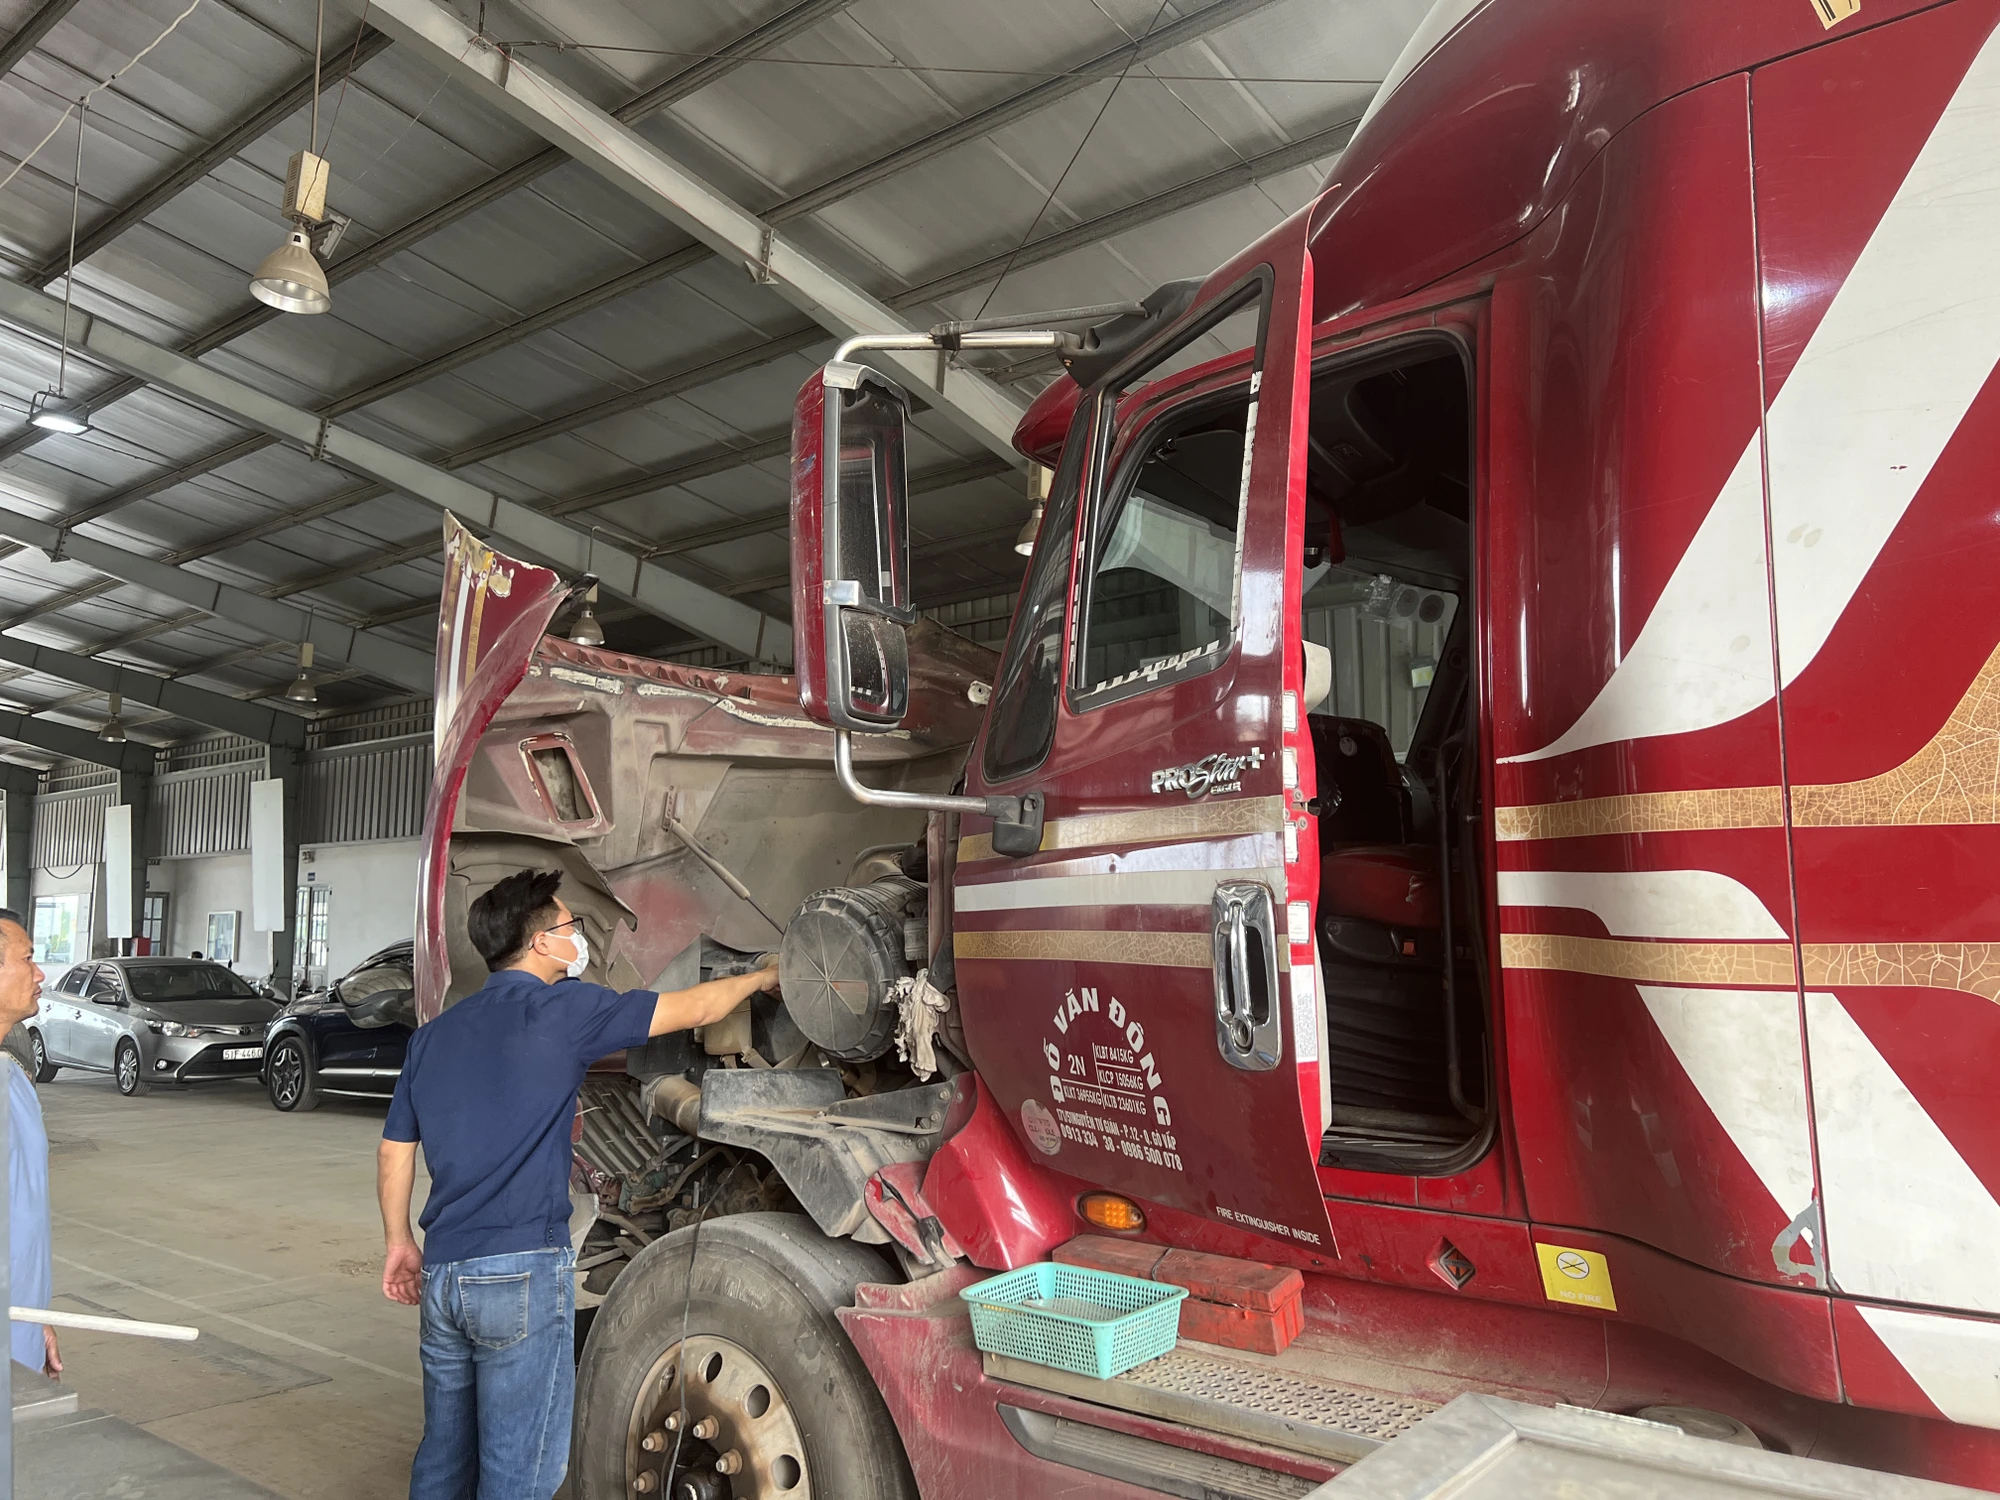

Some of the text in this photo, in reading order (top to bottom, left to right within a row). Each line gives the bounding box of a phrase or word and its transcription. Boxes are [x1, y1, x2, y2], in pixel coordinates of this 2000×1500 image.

[1053, 987, 1100, 1035] VĂN
[1108, 996, 1172, 1127] ĐÔNG
[1067, 1054, 1087, 1077] 2N
[1094, 1045, 1134, 1064] KLBT 8415KG
[1098, 1069, 1114, 1085] KLCP
[1060, 1122, 1083, 1144] 0913
[1081, 1129, 1099, 1148] 334
[1121, 1140, 1145, 1161] 0986
[1143, 1146, 1163, 1166] 500
[1163, 1151, 1183, 1172] 078
[1216, 1206, 1322, 1245] FIRE EXTINGUISHER INSIDE
[1560, 1289, 1603, 1304] NO FIRE
